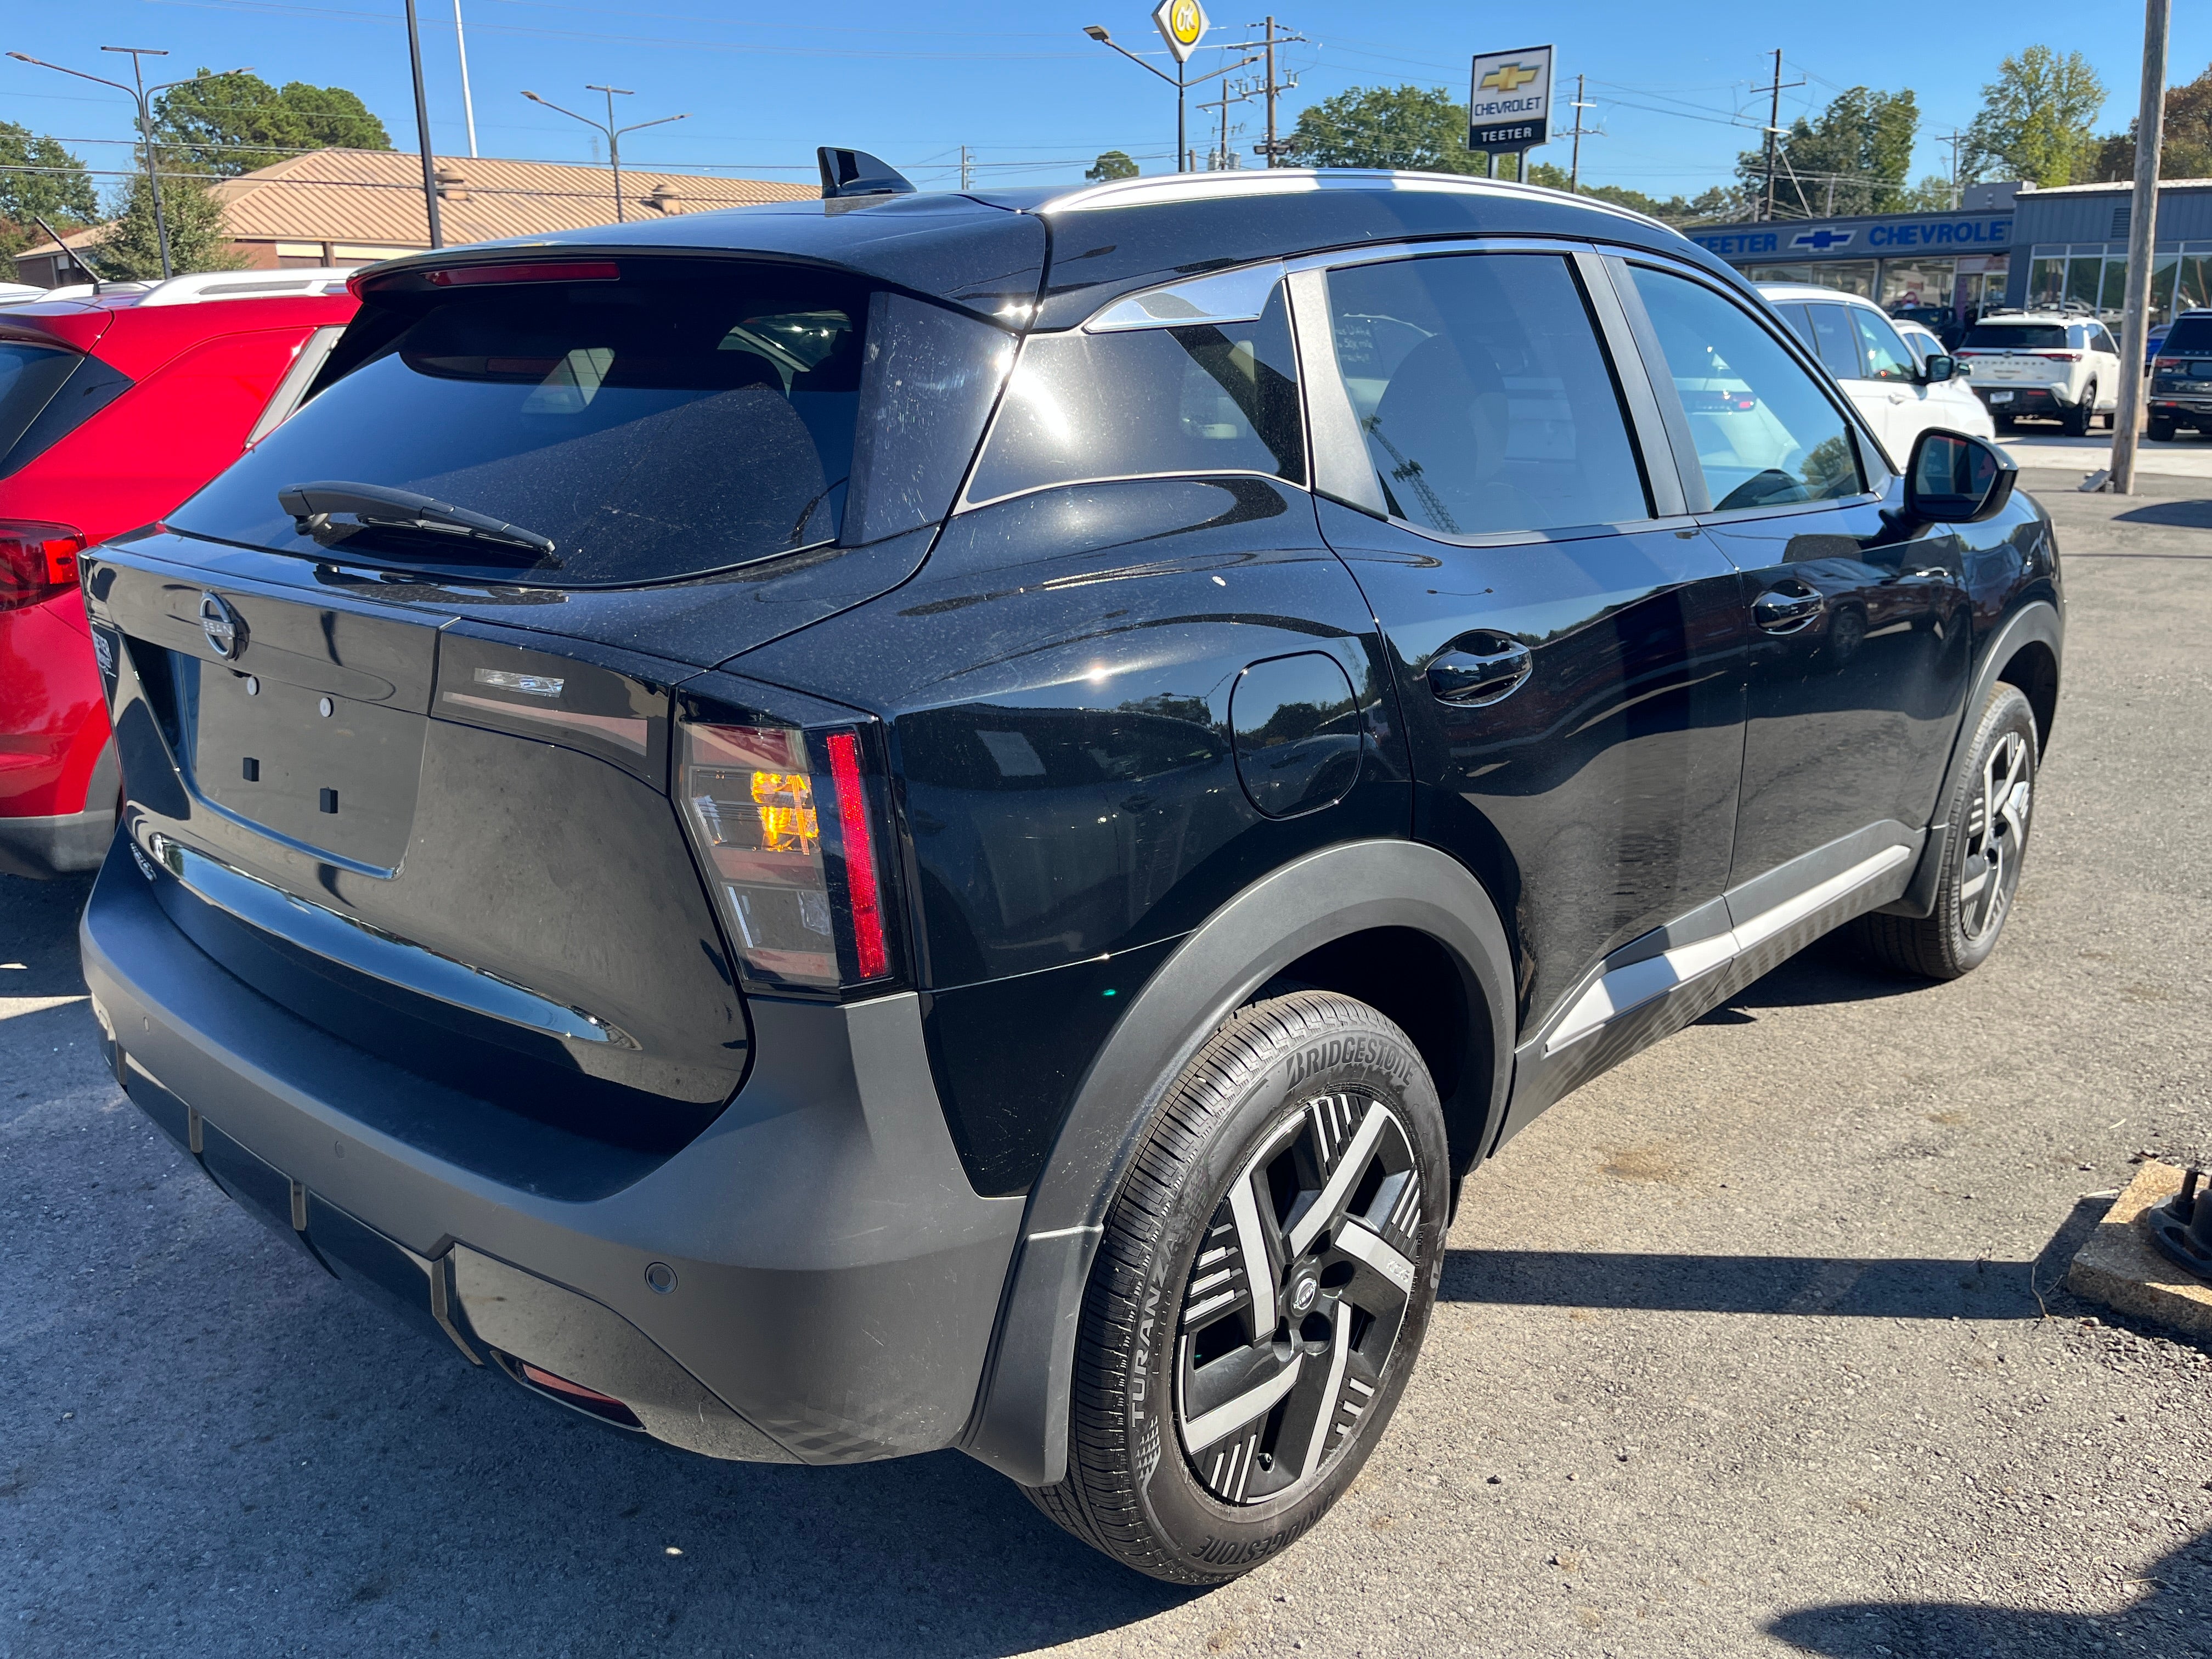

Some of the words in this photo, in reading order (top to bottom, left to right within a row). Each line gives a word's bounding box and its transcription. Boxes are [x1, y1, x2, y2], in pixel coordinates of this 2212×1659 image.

[1176, 4, 1196, 32] OK
[1475, 97, 1542, 116] CHEVROLET
[1481, 127, 1532, 142] TEETER
[1869, 221, 2013, 246] CHEVROLE
[1285, 1036, 1414, 1092] BRIDGESTONE
[1132, 1232, 1180, 1427] TURANZA
